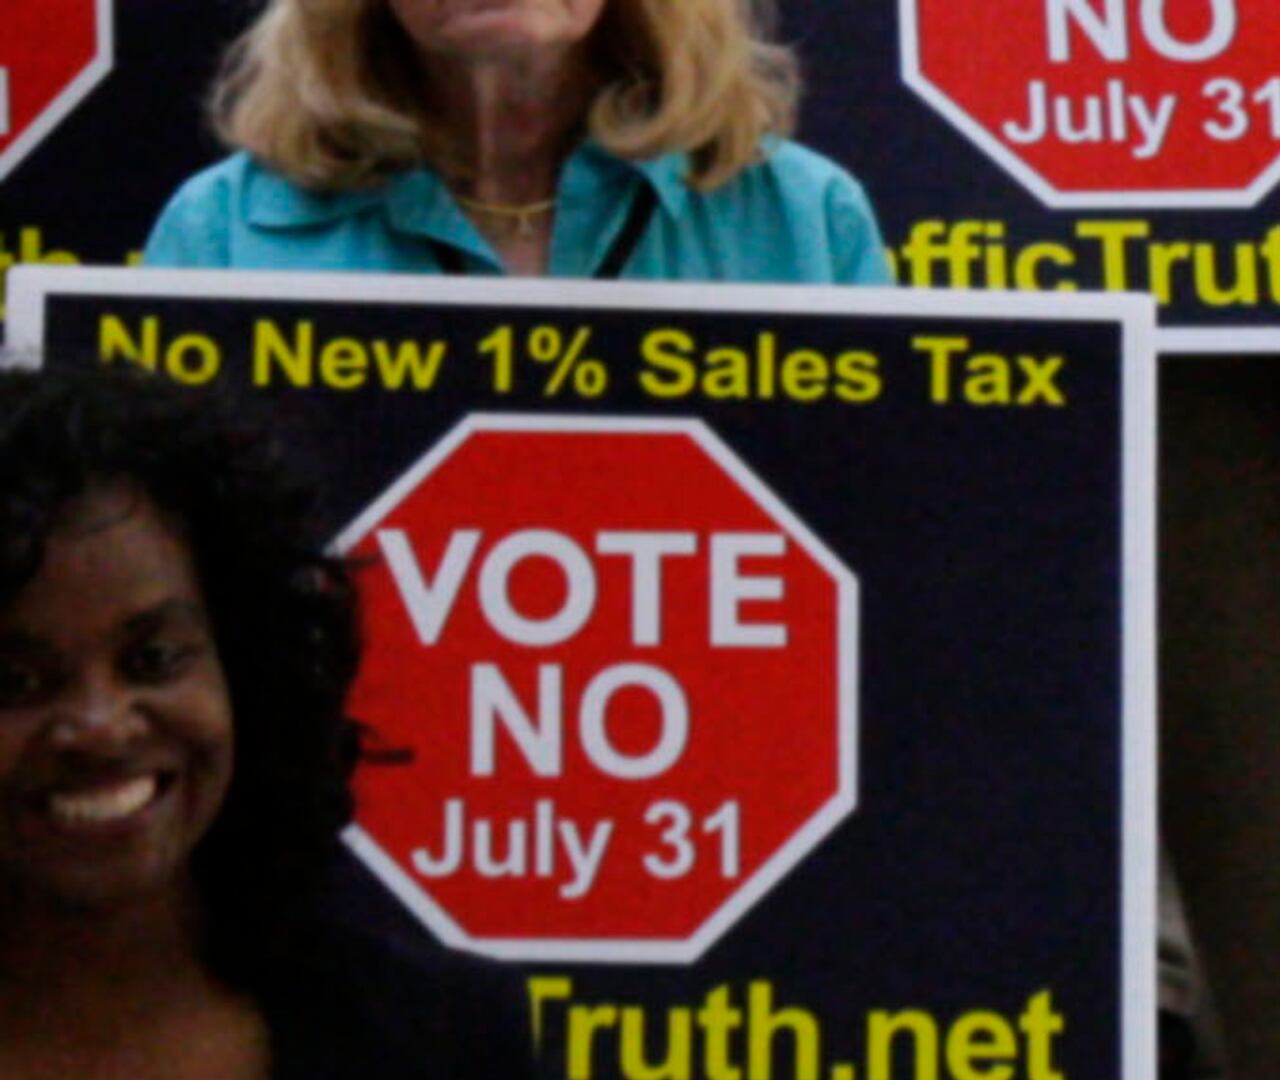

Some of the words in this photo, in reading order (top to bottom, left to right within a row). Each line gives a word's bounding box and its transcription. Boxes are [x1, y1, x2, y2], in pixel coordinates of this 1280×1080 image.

[1046, 0, 1237, 63] NO
[1003, 79, 1176, 159] July
[100, 315, 221, 385] No
[253, 319, 446, 390] New
[479, 326, 608, 397] 1%
[640, 329, 881, 402] Sales
[912, 336, 1065, 405] Tax
[375, 527, 788, 648] VOTE
[470, 662, 689, 780] NO
[411, 798, 612, 900] July
[642, 800, 741, 880] 31
